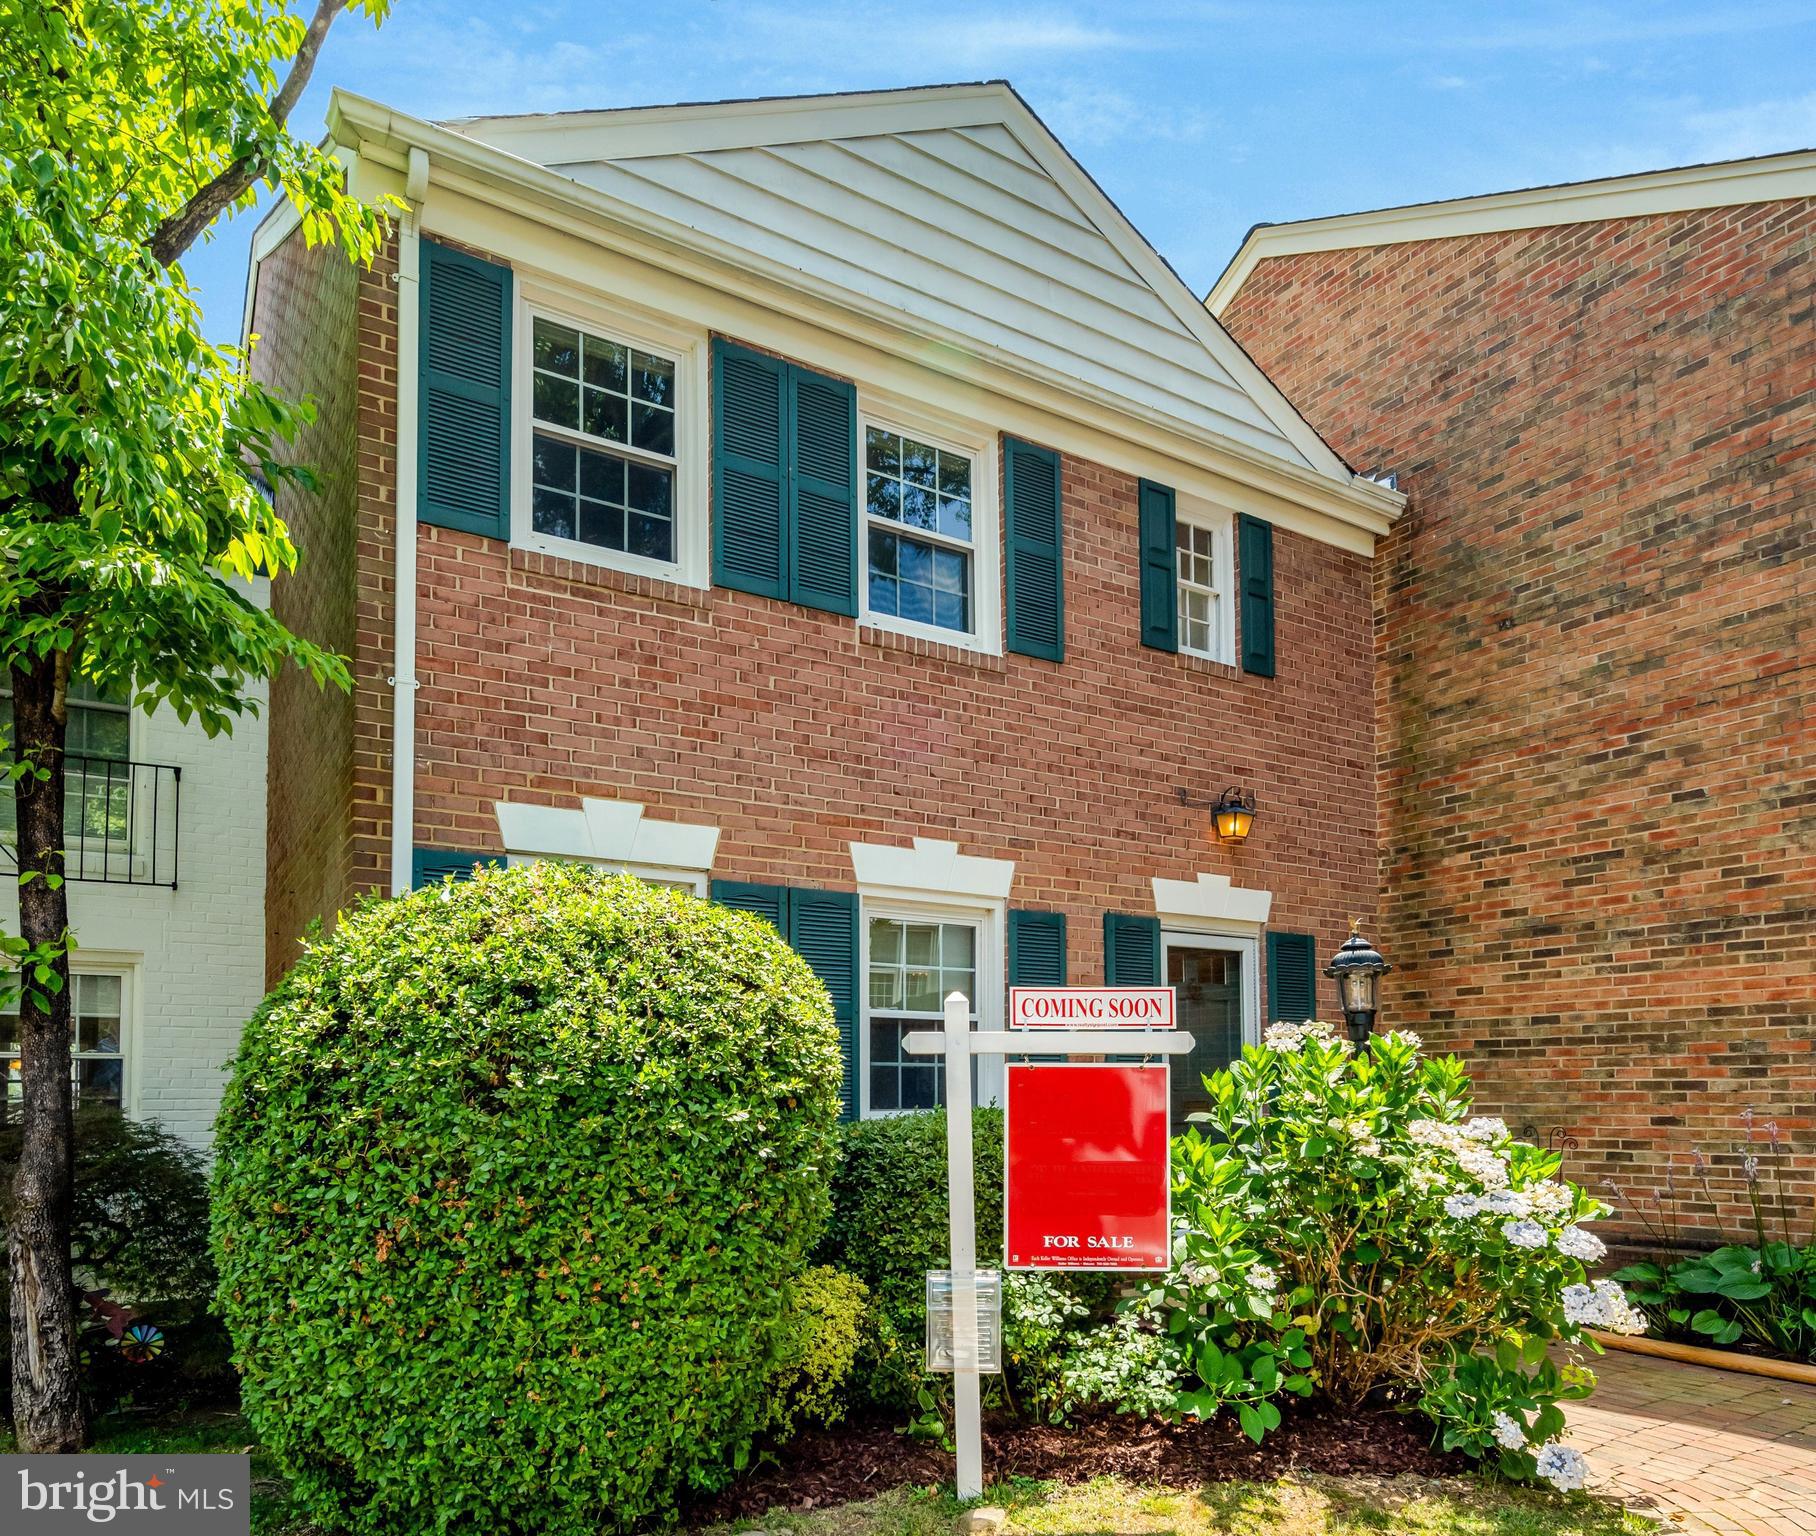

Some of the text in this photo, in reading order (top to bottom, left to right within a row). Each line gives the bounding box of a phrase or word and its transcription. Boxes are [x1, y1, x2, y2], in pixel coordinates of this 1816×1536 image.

[1021, 997, 1162, 1018] COMING SOON
[1043, 1235, 1134, 1248] FOR SALE
